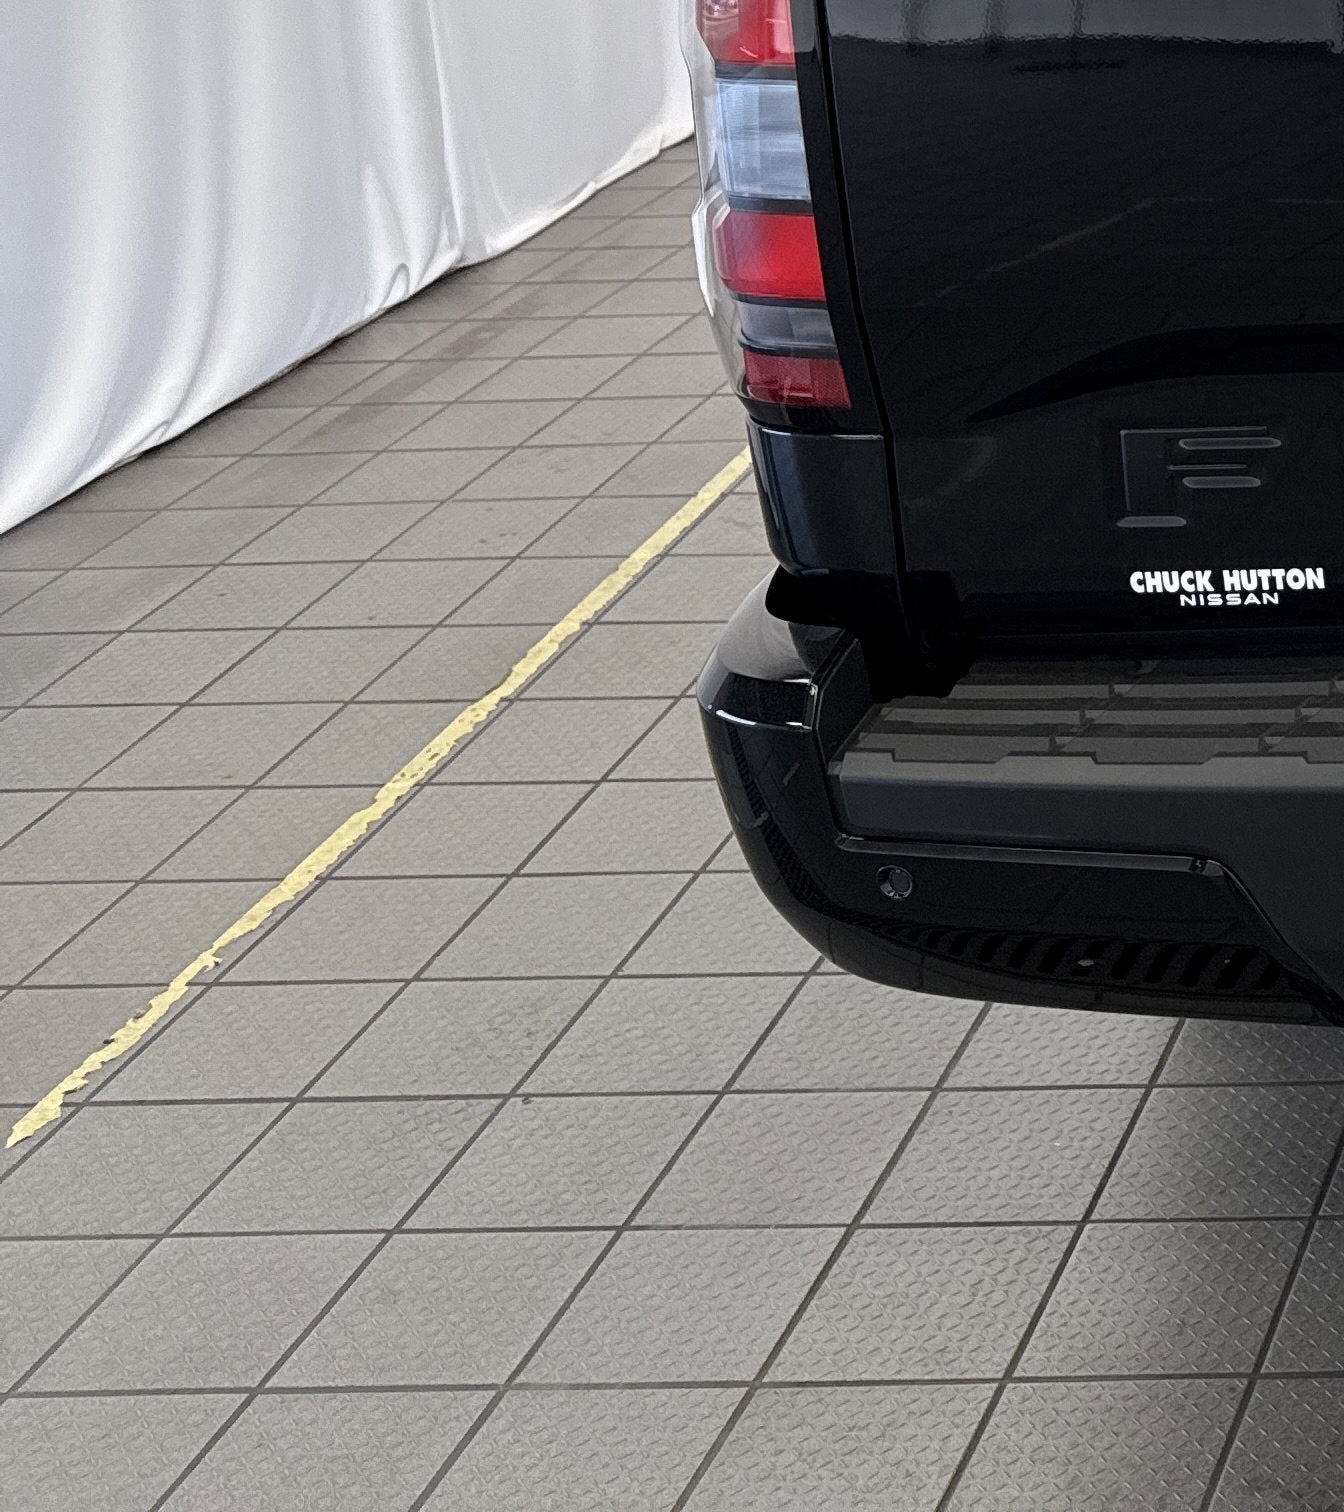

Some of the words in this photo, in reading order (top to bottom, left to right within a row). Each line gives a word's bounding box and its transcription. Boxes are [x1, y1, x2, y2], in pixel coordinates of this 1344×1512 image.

[1129, 570, 1215, 594] CHUCK
[1222, 567, 1326, 591] HUTTON
[1180, 592, 1280, 607] NISSAN
